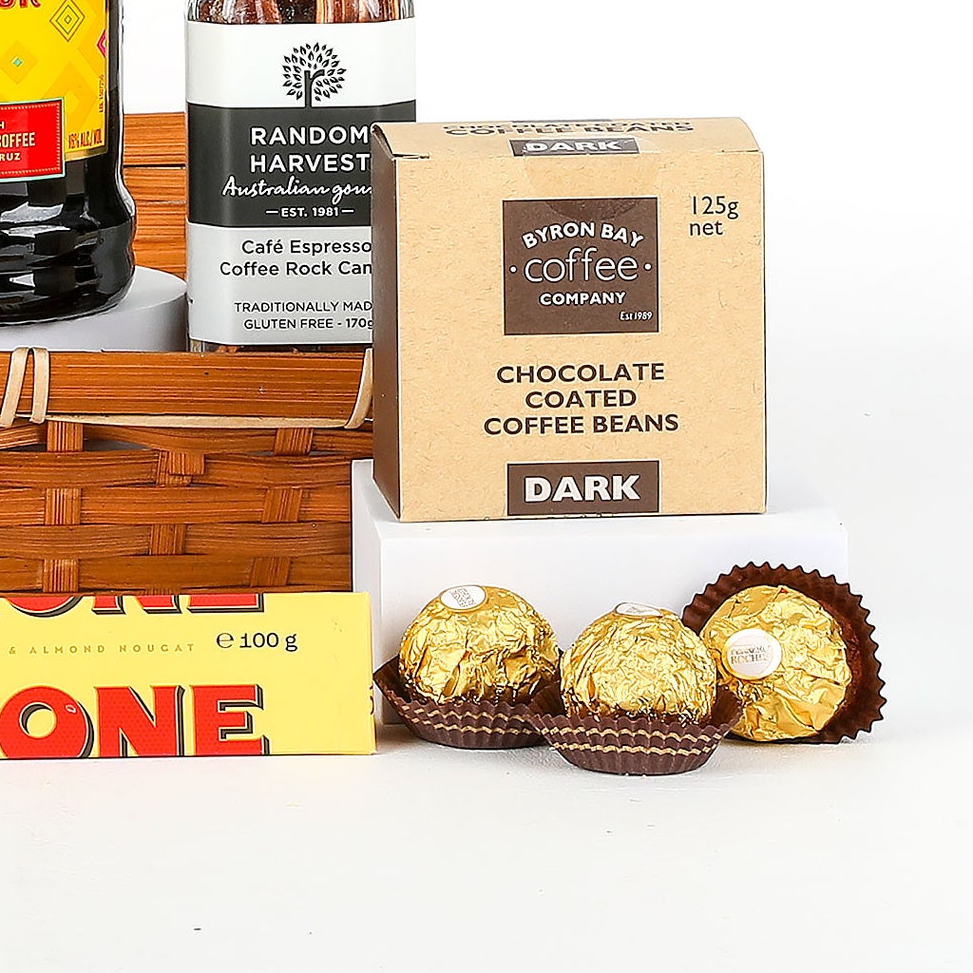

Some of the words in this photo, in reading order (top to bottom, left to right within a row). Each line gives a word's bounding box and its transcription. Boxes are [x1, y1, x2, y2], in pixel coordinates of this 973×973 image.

[251, 126, 370, 146] RANDOM
[446, 127, 576, 135] COFFEE
[584, 125, 694, 133] BEANS
[525, 141, 622, 152] DARK
[250, 153, 371, 173] HARVEST
[222, 175, 329, 197] Australian
[331, 184, 372, 205] gou
[281, 207, 308, 217] EST.
[313, 206, 339, 217] 1981
[691, 195, 739, 220] 125g
[522, 220, 595, 249] BYRON
[600, 223, 644, 248] BAY
[689, 221, 724, 237] net
[241, 239, 283, 254] Café
[291, 240, 372, 256] Espresso
[220, 262, 280, 276] Coffee
[287, 261, 332, 275] Rock
[339, 261, 372, 274] Can
[524, 247, 639, 282] coffee
[235, 301, 339, 313] TRADITIONALLY
[343, 300, 373, 312] MAD
[539, 292, 626, 305] COMPANY
[244, 319, 296, 330] GLUTEN
[300, 319, 333, 329] FREE
[496, 363, 665, 384] CHOCOLATE
[525, 390, 637, 408] COATED
[484, 416, 584, 435] COFFEE
[593, 414, 679, 433] BEANS
[524, 475, 640, 502] DARK
[8, 646, 17, 655] &
[29, 645, 106, 655] ALMOND
[119, 643, 195, 653] NOUGAT
[239, 633, 279, 649] 100
[285, 633, 298, 652] g
